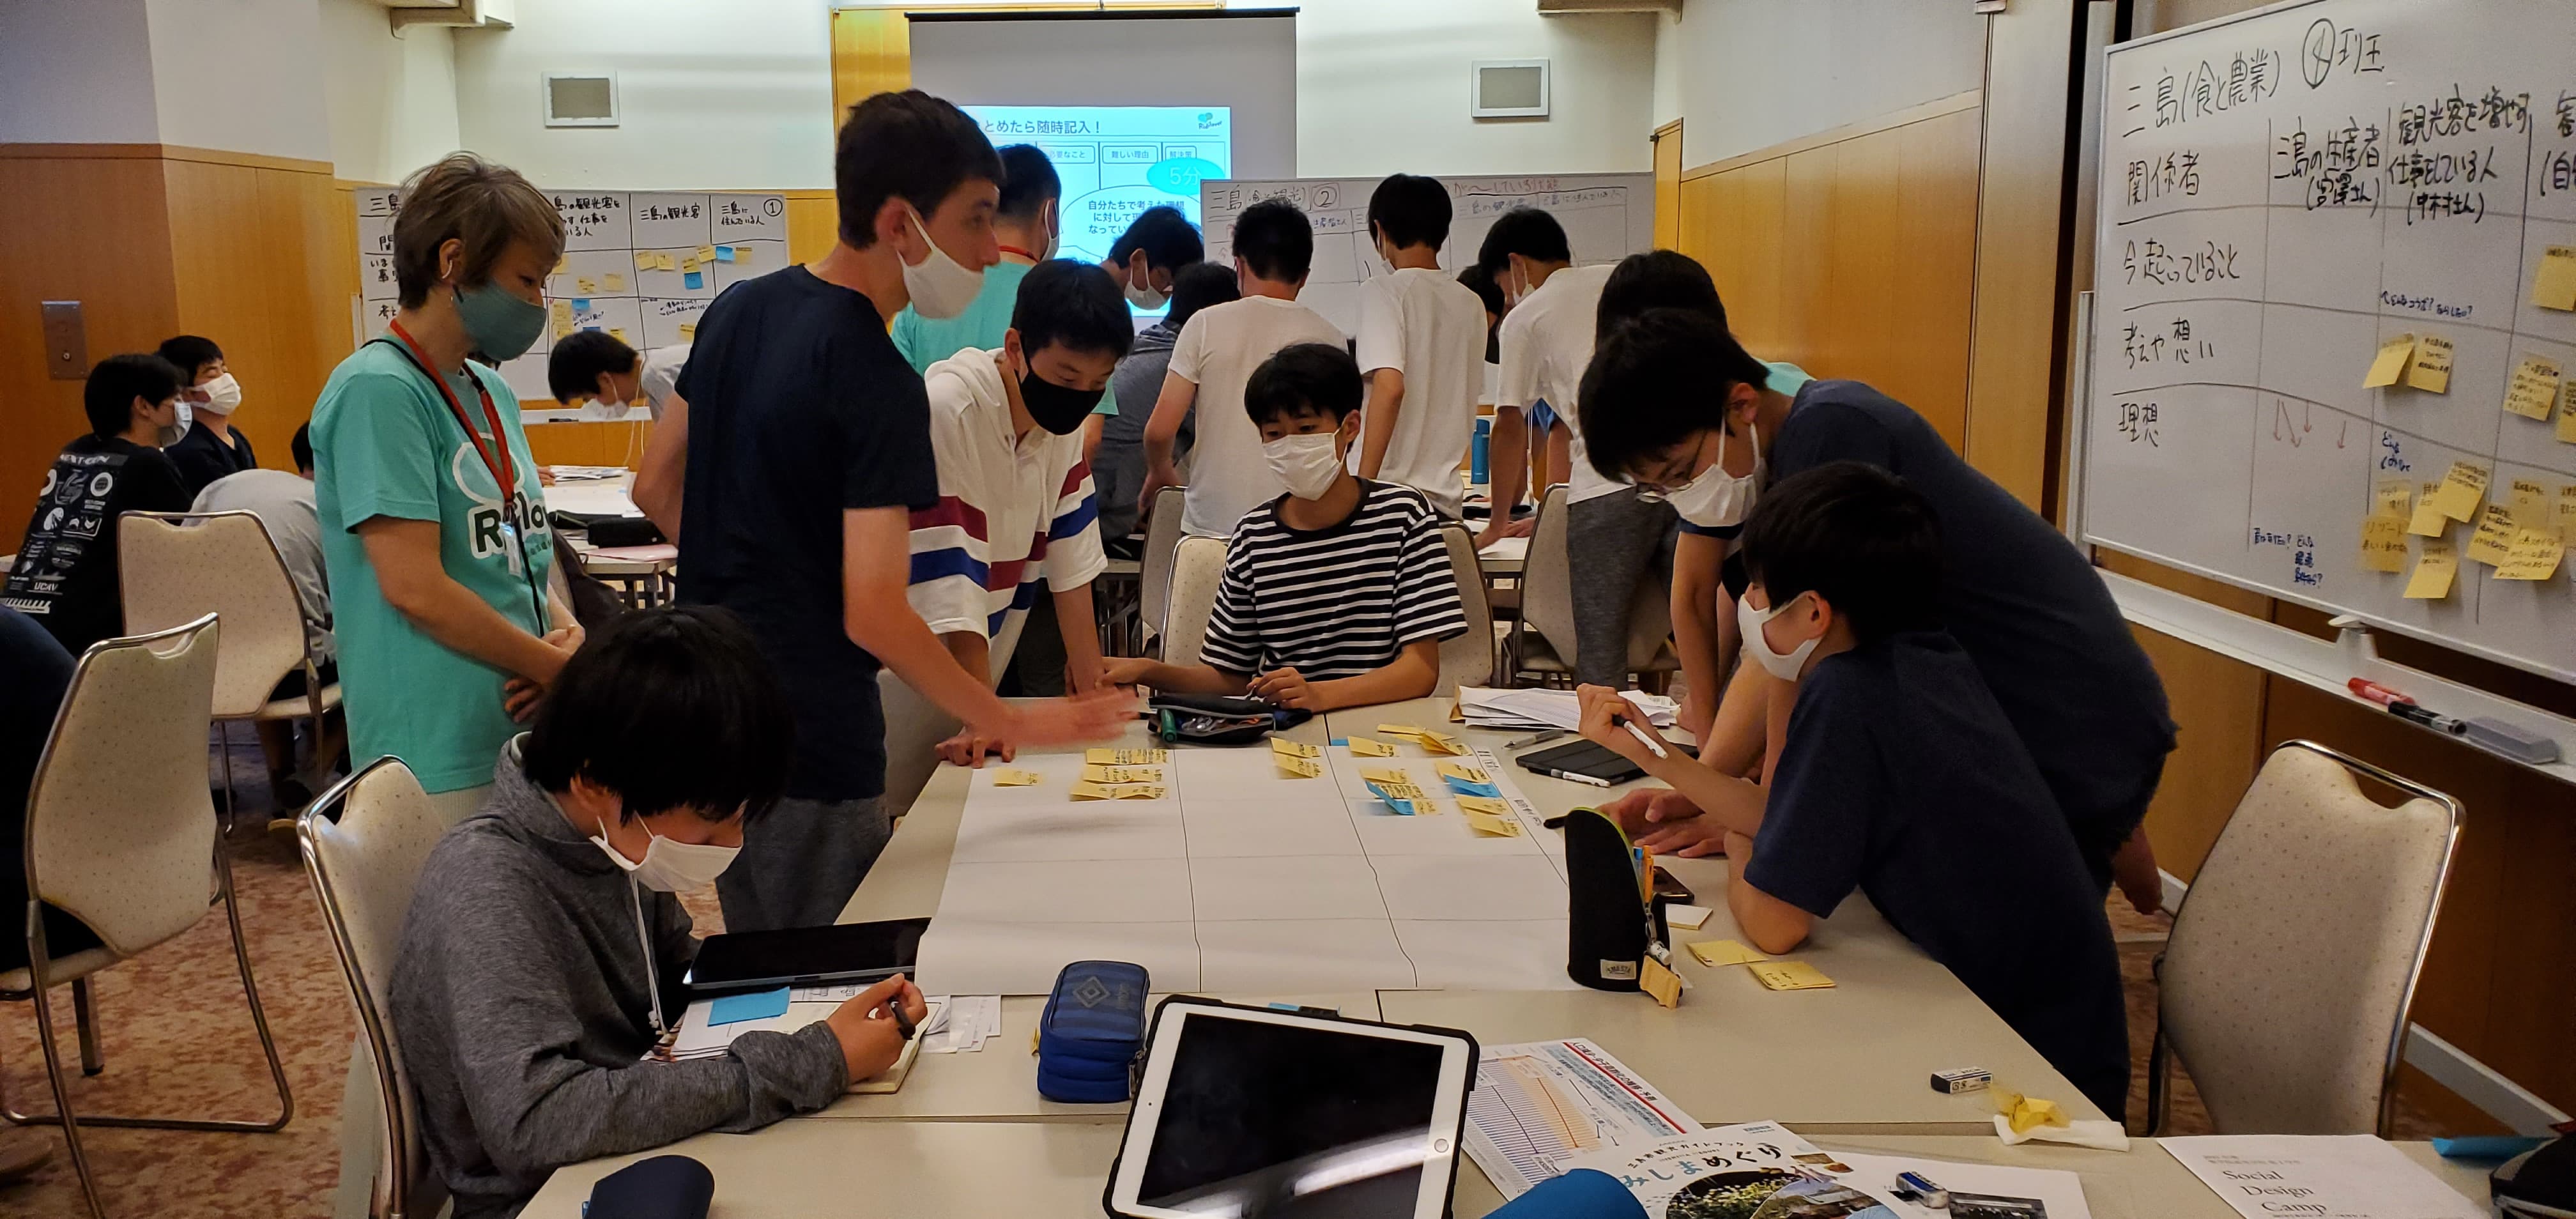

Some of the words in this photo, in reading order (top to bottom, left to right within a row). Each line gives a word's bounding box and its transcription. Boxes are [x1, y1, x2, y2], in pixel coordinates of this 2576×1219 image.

[2127, 150, 2200, 206] 関係者
[2118, 402, 2159, 447] 理想
[2223, 1170, 2285, 1180] Social
[2240, 1186, 2316, 1199] Design
[2261, 1202, 2327, 1215] Camp
